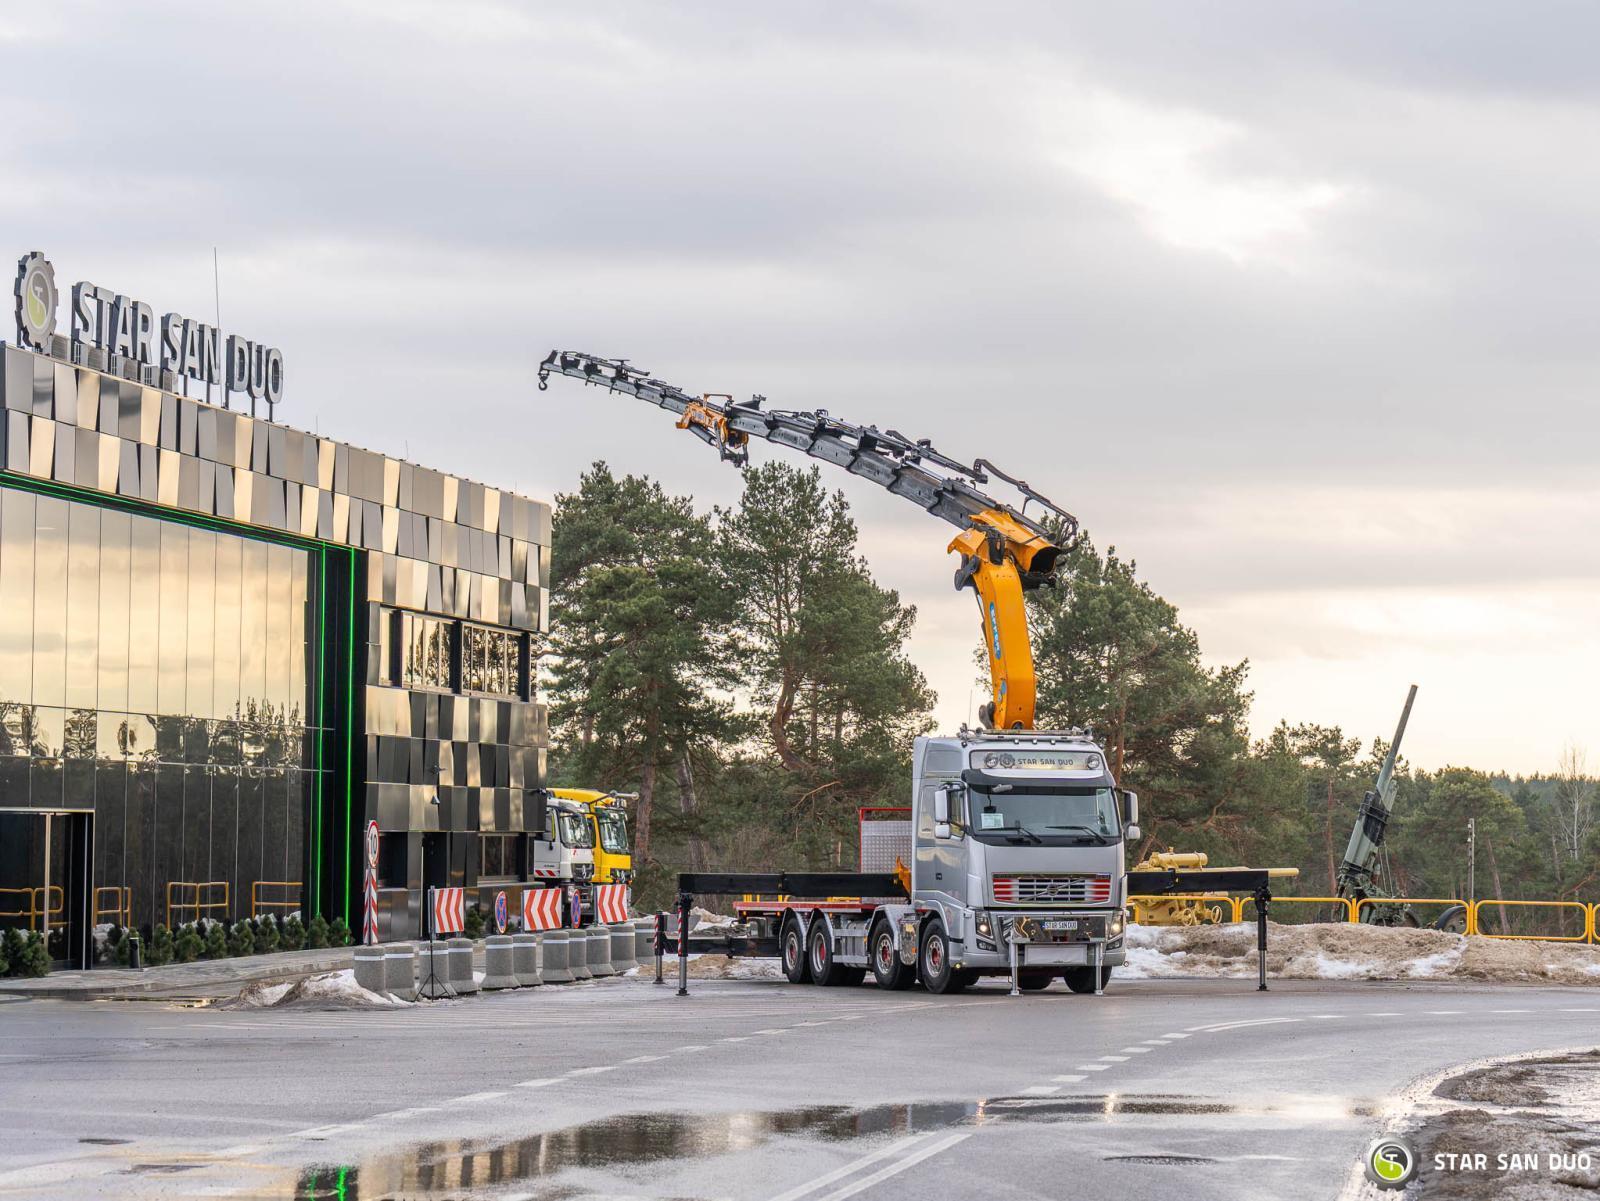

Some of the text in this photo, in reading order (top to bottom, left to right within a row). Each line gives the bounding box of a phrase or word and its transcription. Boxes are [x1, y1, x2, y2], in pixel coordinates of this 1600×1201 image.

[72, 281, 284, 403] STAR SAN DUO
